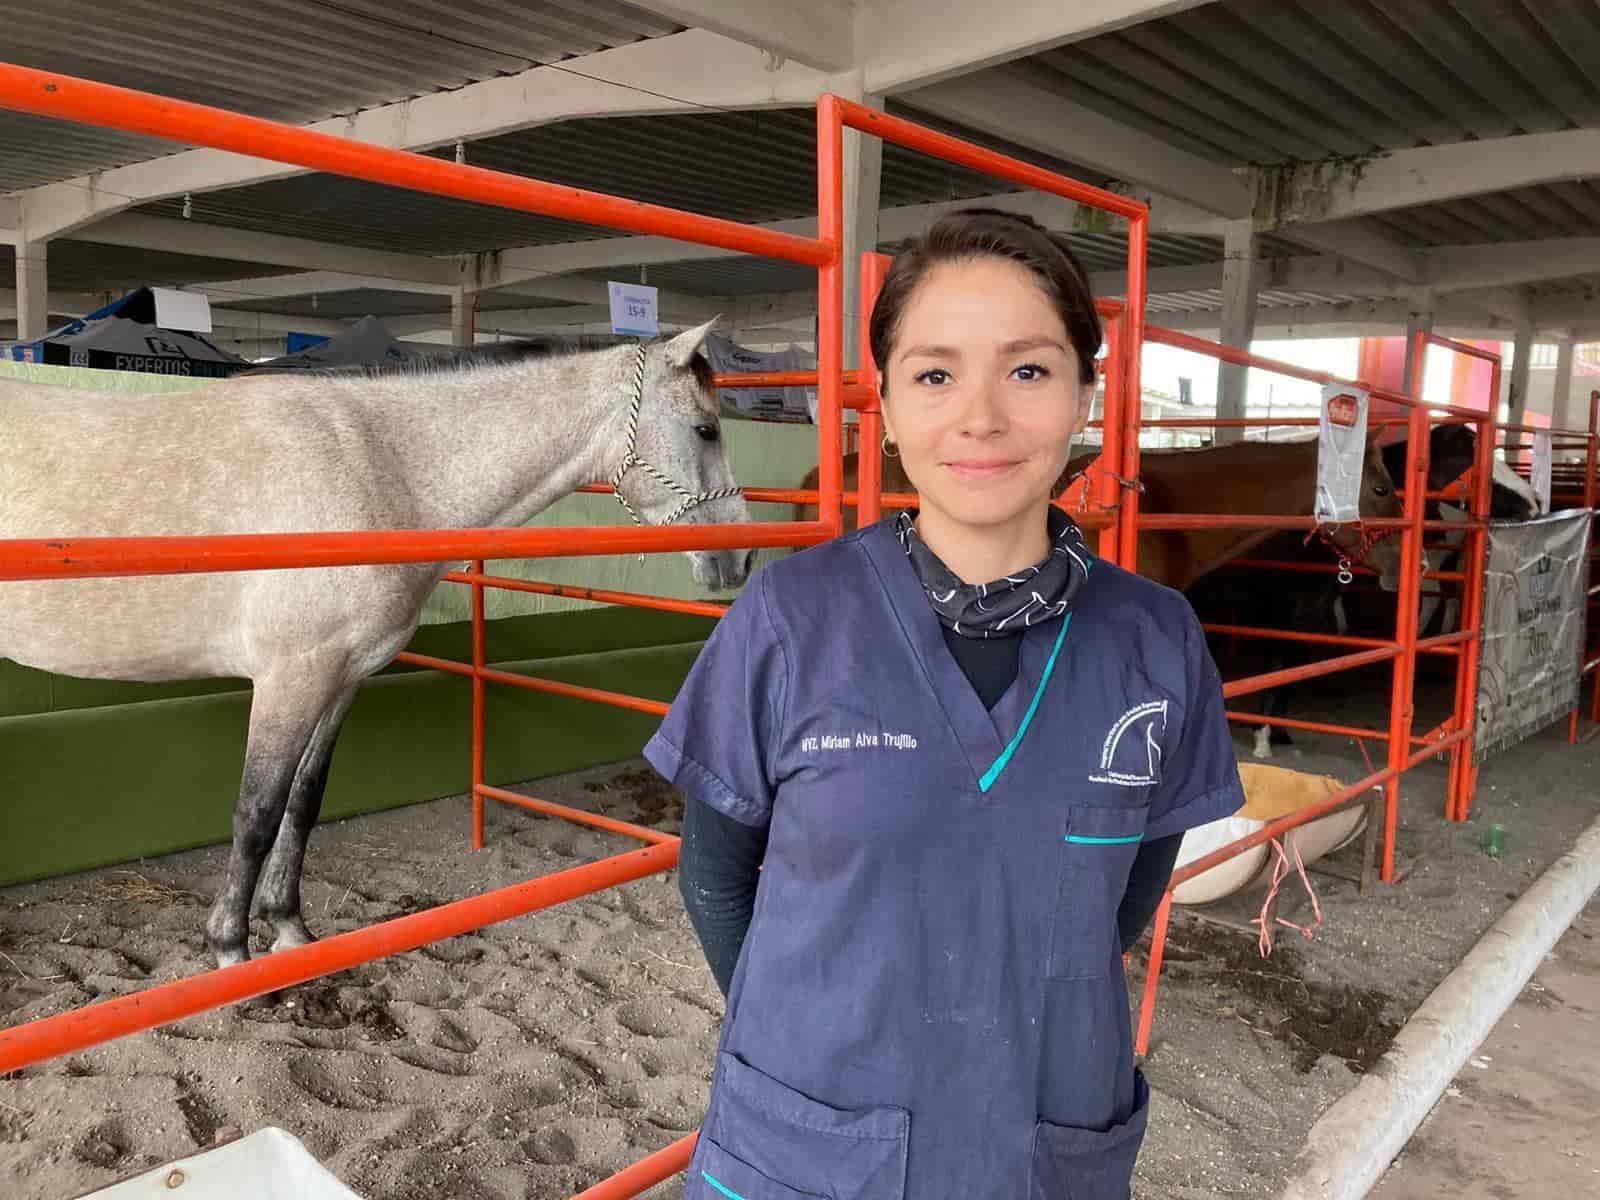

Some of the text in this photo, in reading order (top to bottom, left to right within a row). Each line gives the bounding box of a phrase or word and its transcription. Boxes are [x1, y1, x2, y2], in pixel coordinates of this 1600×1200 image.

[115, 355, 192, 376] EXPERTOS
[821, 735, 851, 752] Miriam
[855, 732, 878, 748] Alva
[883, 732, 918, 750] Trujillo
